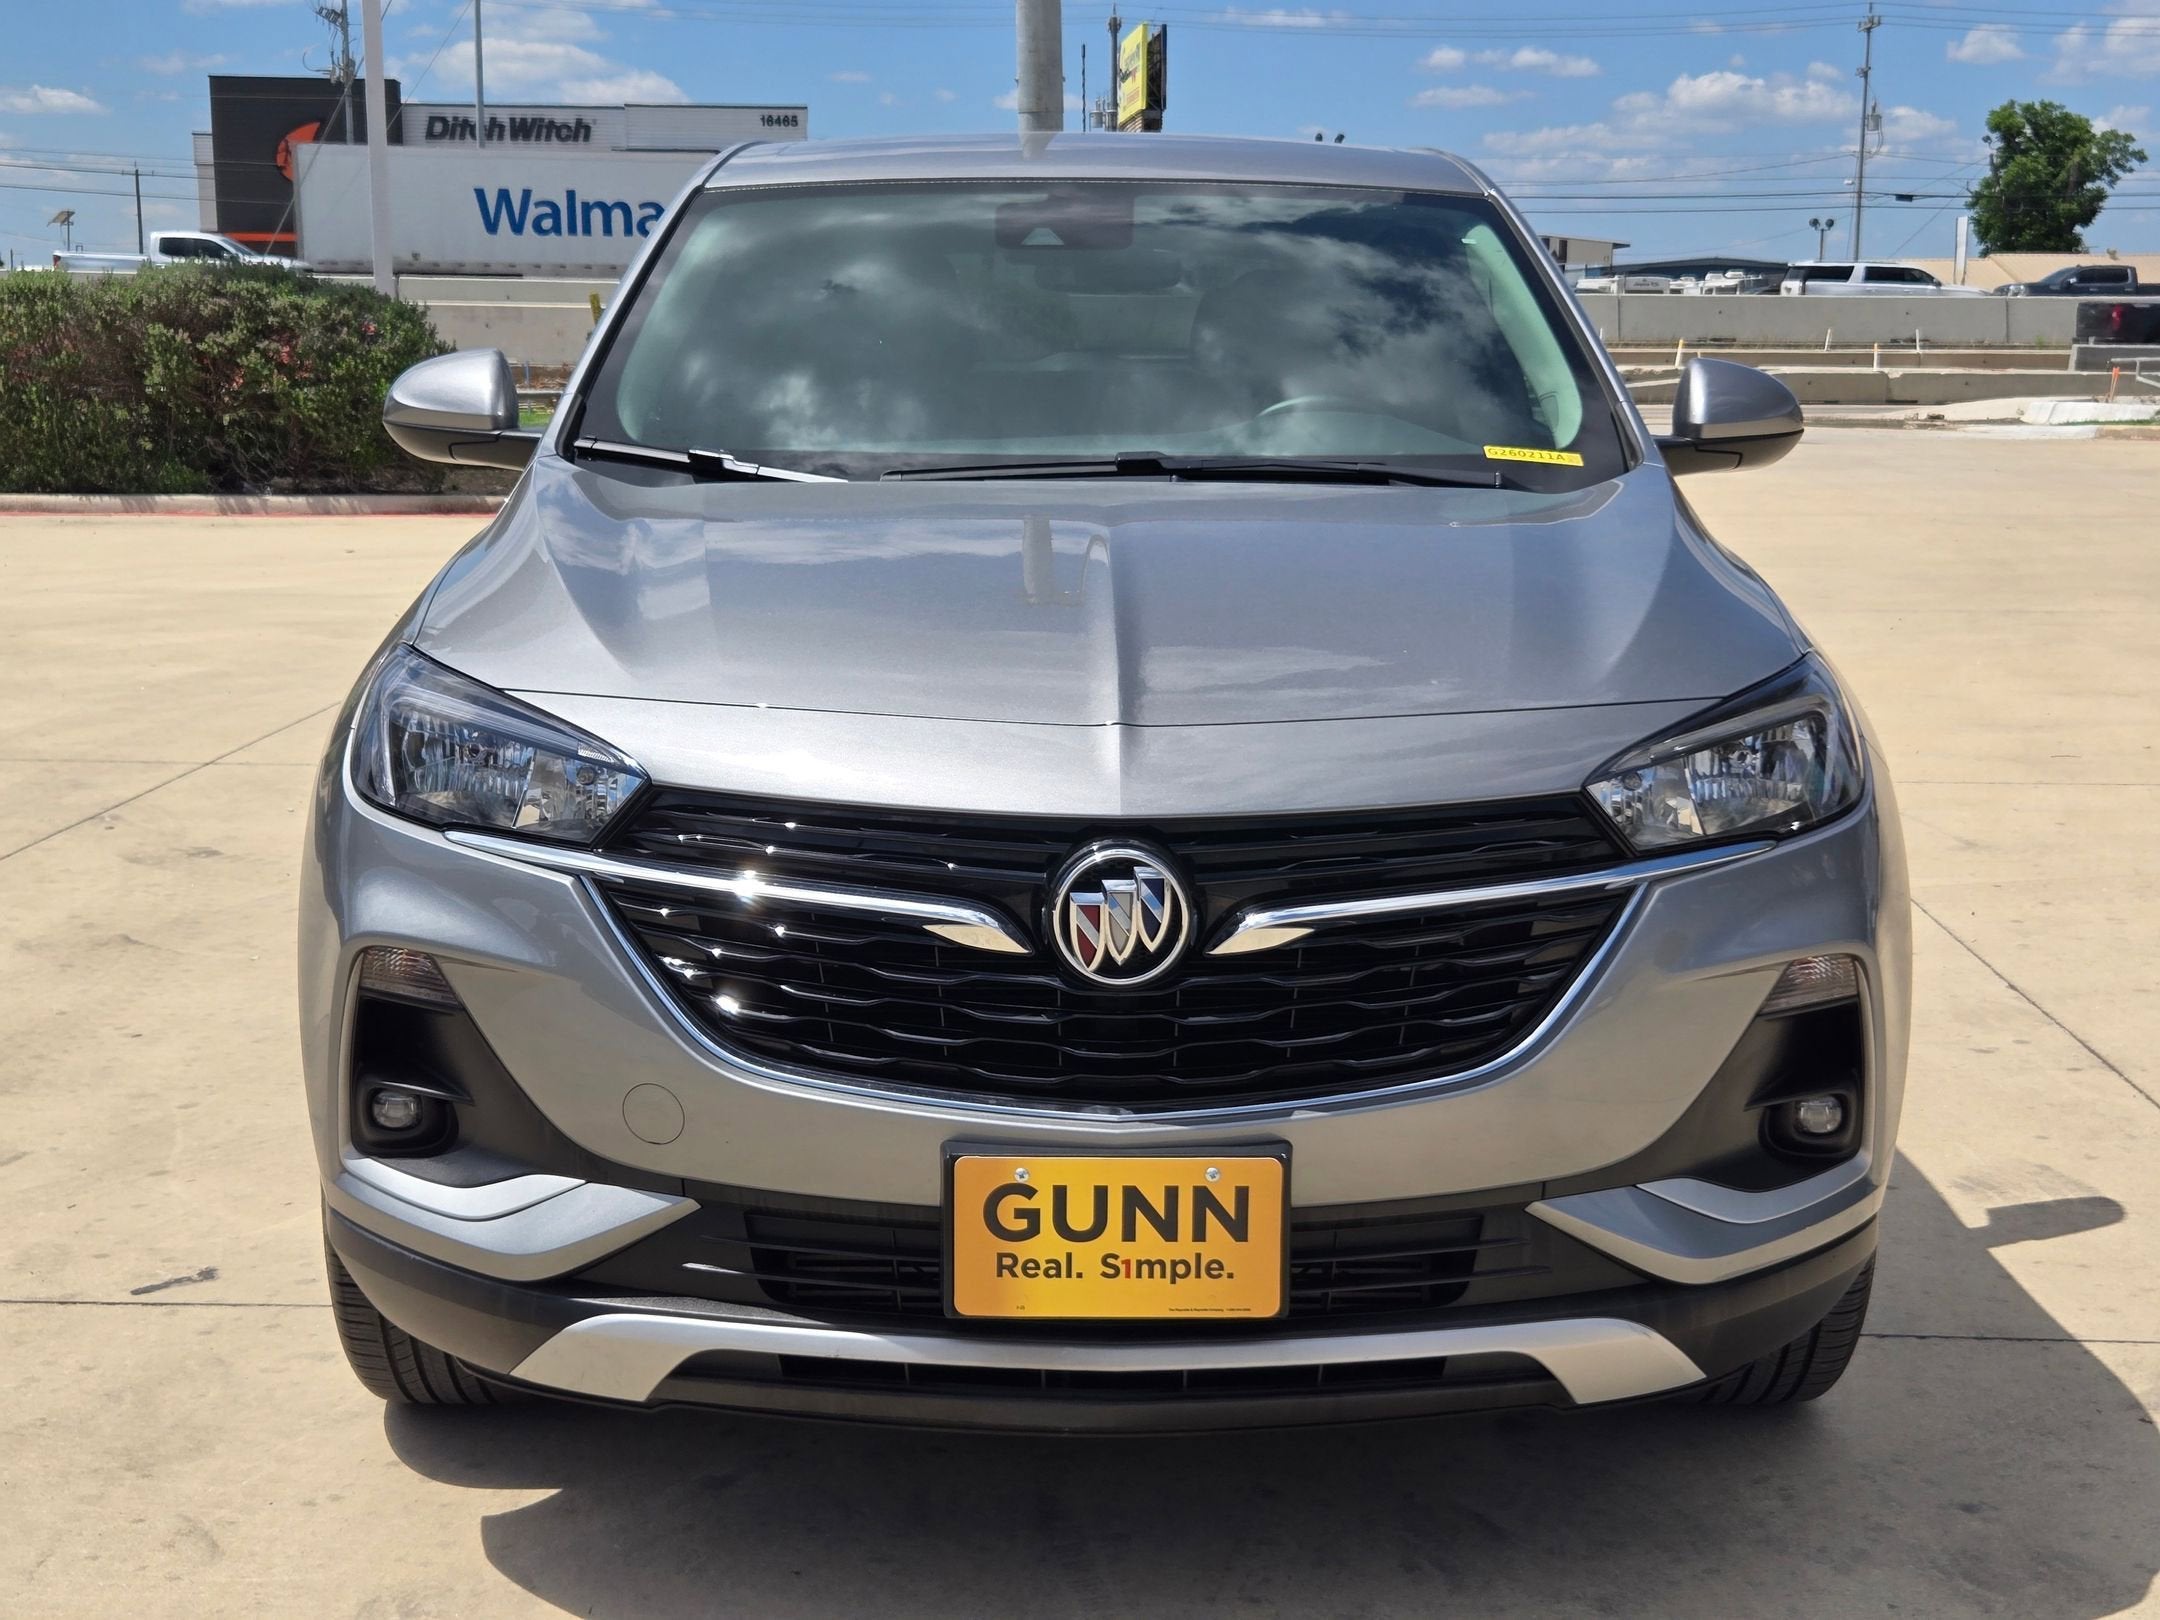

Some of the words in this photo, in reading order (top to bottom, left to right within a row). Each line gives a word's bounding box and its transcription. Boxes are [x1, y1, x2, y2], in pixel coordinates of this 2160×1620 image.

[509, 117, 592, 142] Witch
[1488, 448, 1565, 461] G260211A
[983, 1182, 1250, 1243] GUNN
[996, 1252, 1083, 1279] Real.
[1100, 1252, 1234, 1285] S1mple.
